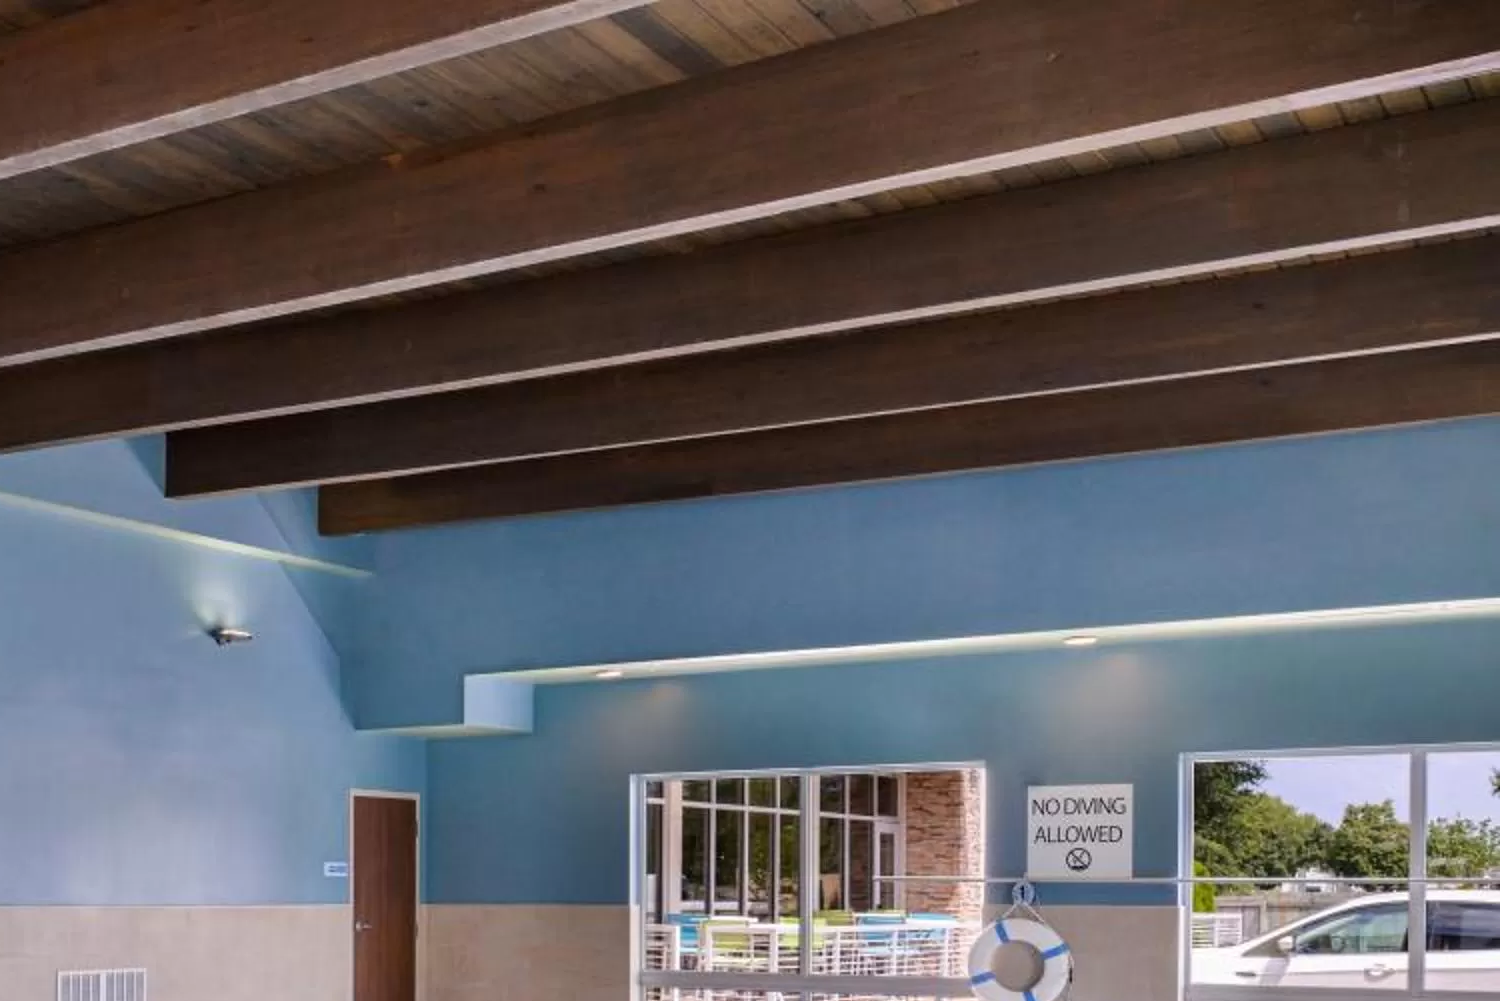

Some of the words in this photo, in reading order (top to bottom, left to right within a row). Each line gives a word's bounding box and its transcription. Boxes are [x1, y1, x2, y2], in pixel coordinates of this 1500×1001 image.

[1031, 797, 1061, 816] NO
[1063, 796, 1127, 815] DIVING
[1033, 825, 1124, 844] ALLOWED
